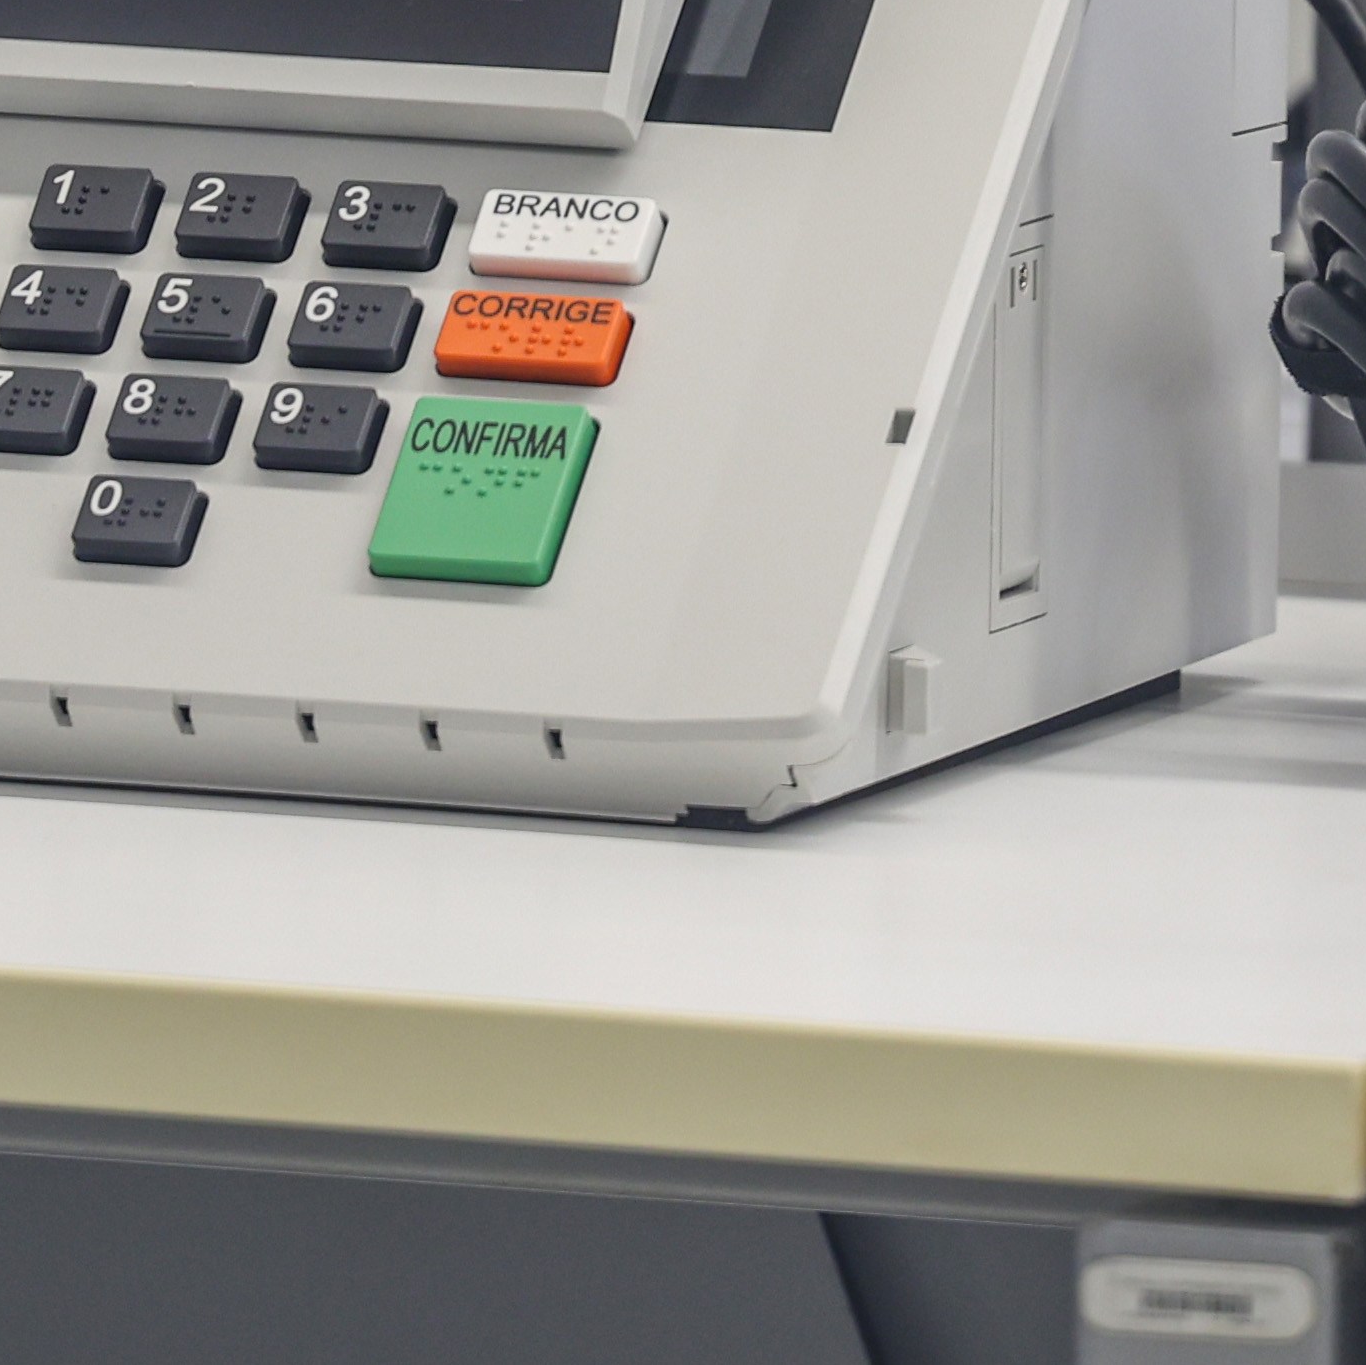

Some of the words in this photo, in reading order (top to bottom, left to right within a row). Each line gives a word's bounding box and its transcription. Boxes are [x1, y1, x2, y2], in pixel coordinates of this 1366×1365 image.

[51, 170, 76, 205] 1
[188, 177, 227, 213] 2
[338, 185, 371, 221] 3
[493, 193, 640, 224] BRANCO
[11, 270, 42, 306] 4
[156, 278, 193, 314] 5
[304, 286, 338, 323] 6
[453, 293, 615, 326] CORRIGE
[122, 378, 156, 415] 8
[270, 387, 304, 424] 9
[411, 417, 567, 462] CONFIRMA
[90, 480, 123, 517] 0
